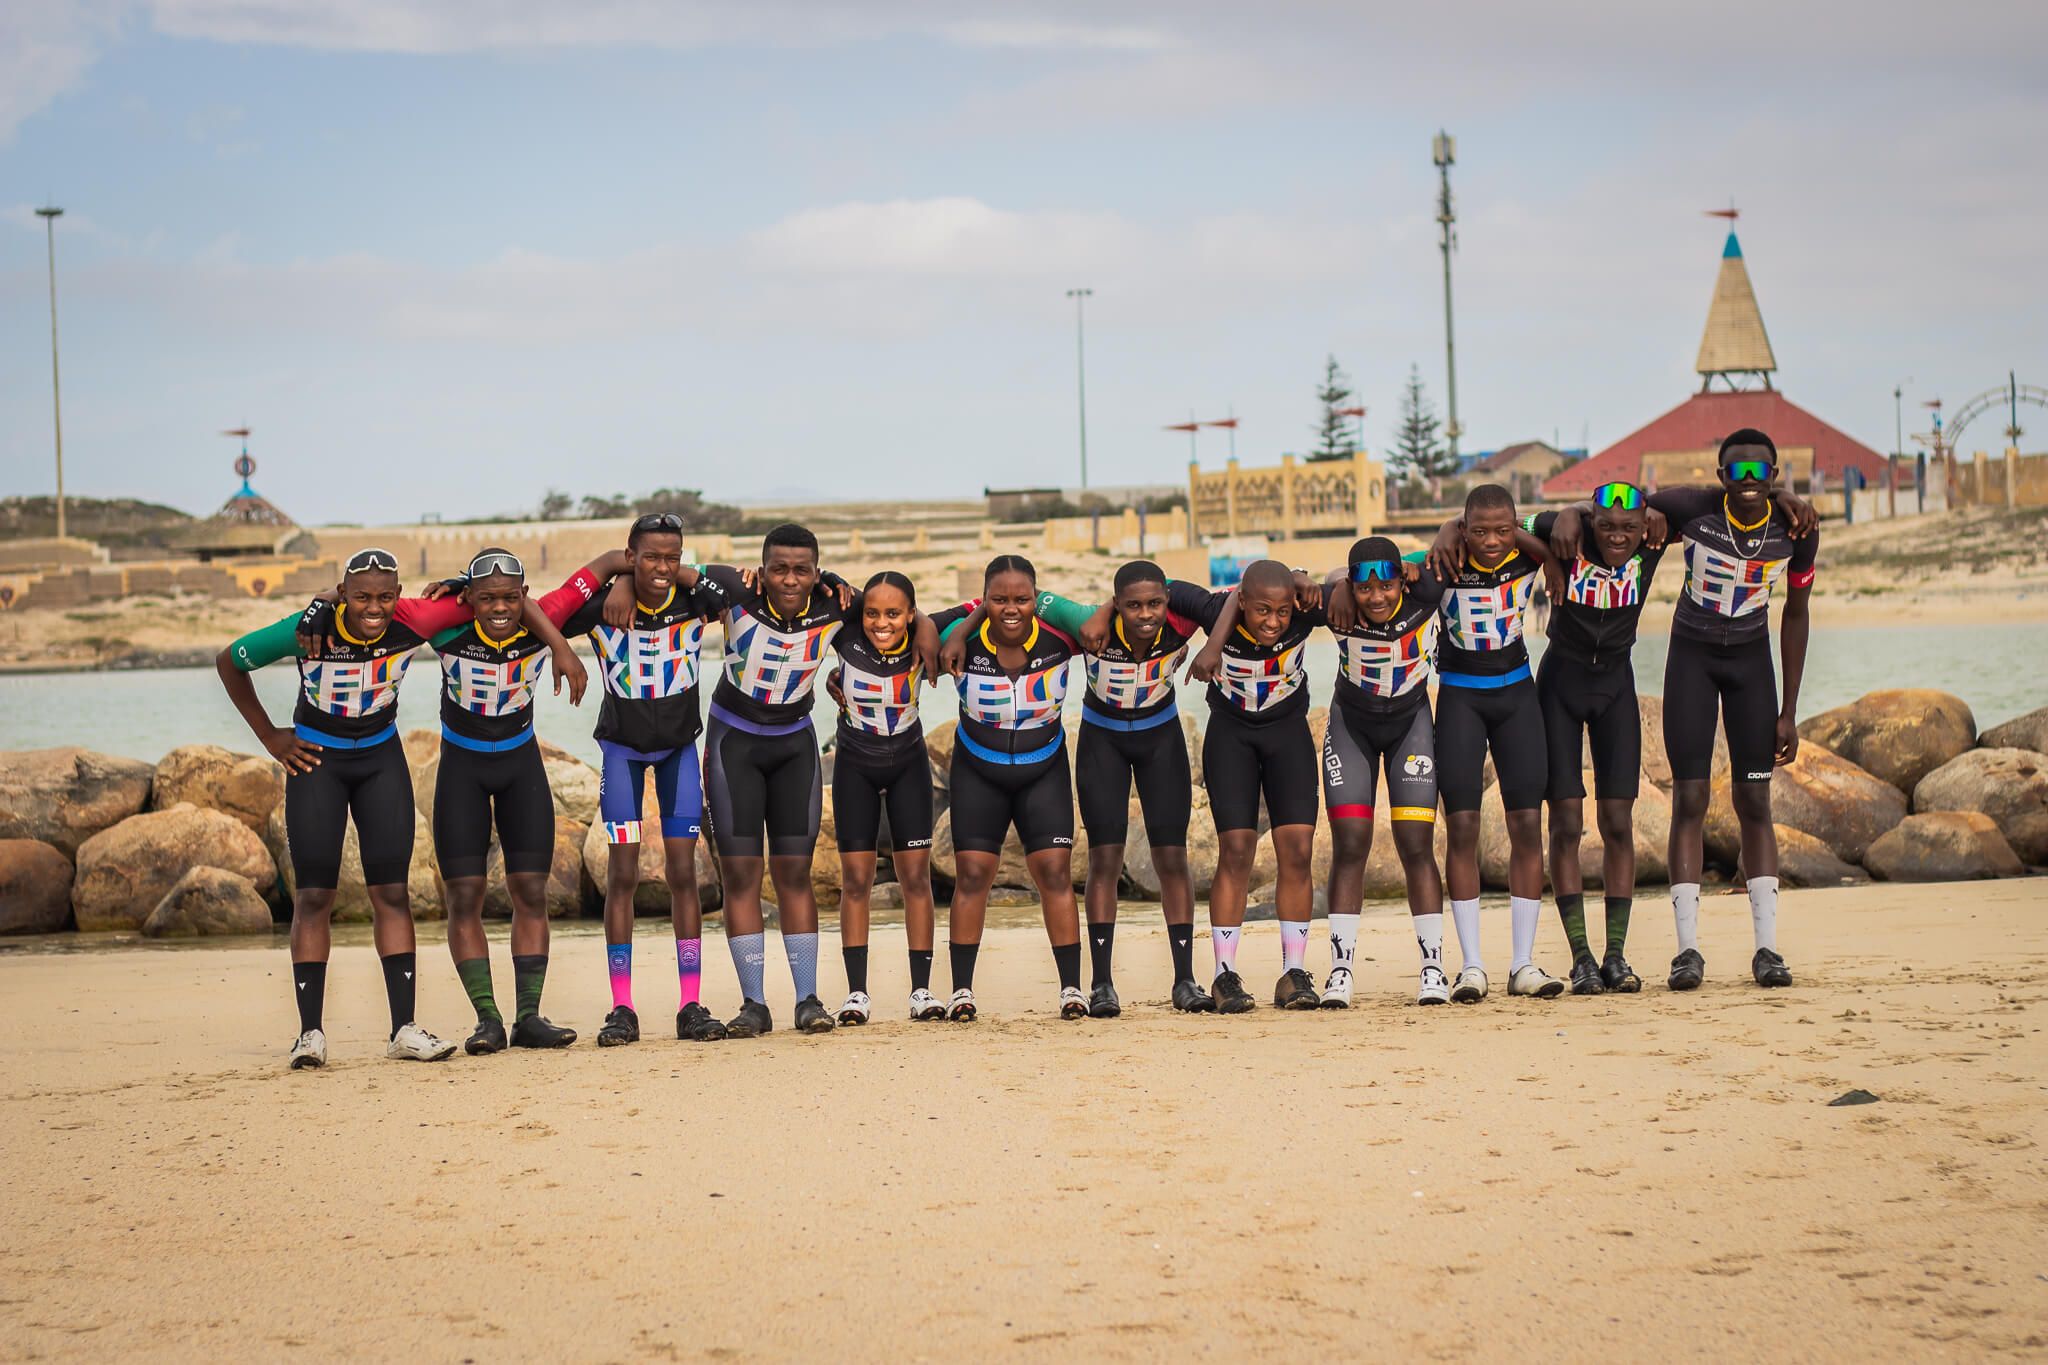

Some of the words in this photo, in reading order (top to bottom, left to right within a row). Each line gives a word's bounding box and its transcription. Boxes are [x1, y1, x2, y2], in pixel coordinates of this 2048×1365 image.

[700, 576, 724, 595] FOX
[302, 600, 323, 624] FOX
[460, 650, 490, 660] exinity
[968, 664, 996, 674] exinity
[1326, 754, 1344, 786] Pay
